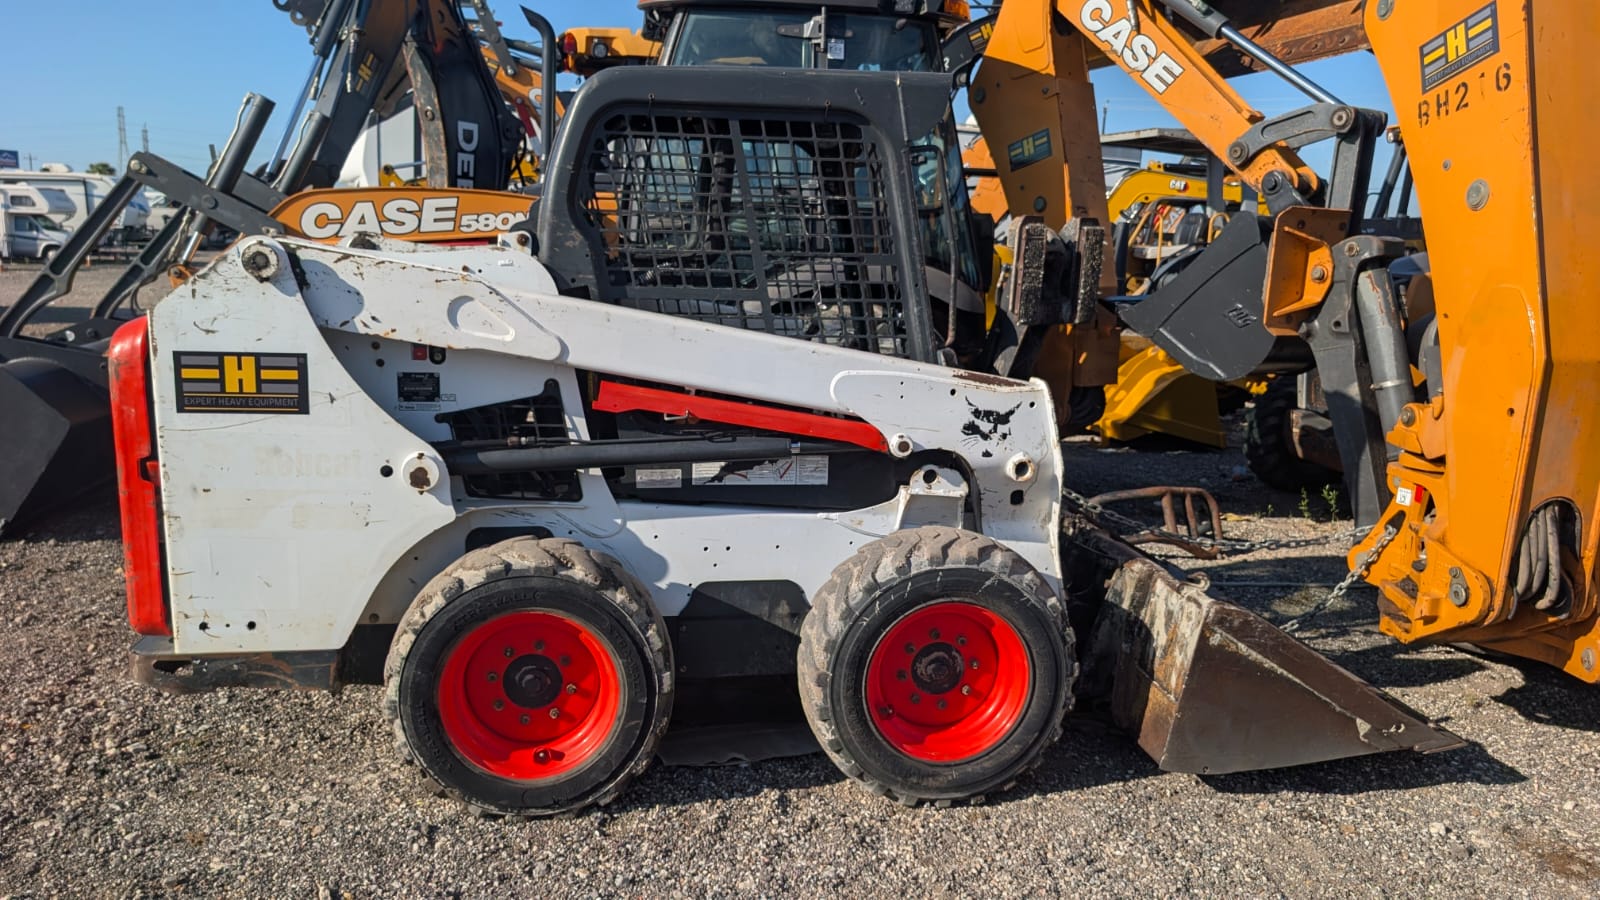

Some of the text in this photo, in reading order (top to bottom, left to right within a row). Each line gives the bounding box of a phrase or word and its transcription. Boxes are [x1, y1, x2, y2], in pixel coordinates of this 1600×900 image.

[1080, 0, 1185, 95] CASE
[1446, 22, 1467, 62] H
[1418, 62, 1511, 128] BH26
[1022, 136, 1035, 157] H
[300, 196, 459, 239] CASE
[223, 355, 257, 393] H
[184, 396, 299, 407] EXPERT HEAVY EQUIPMENT
